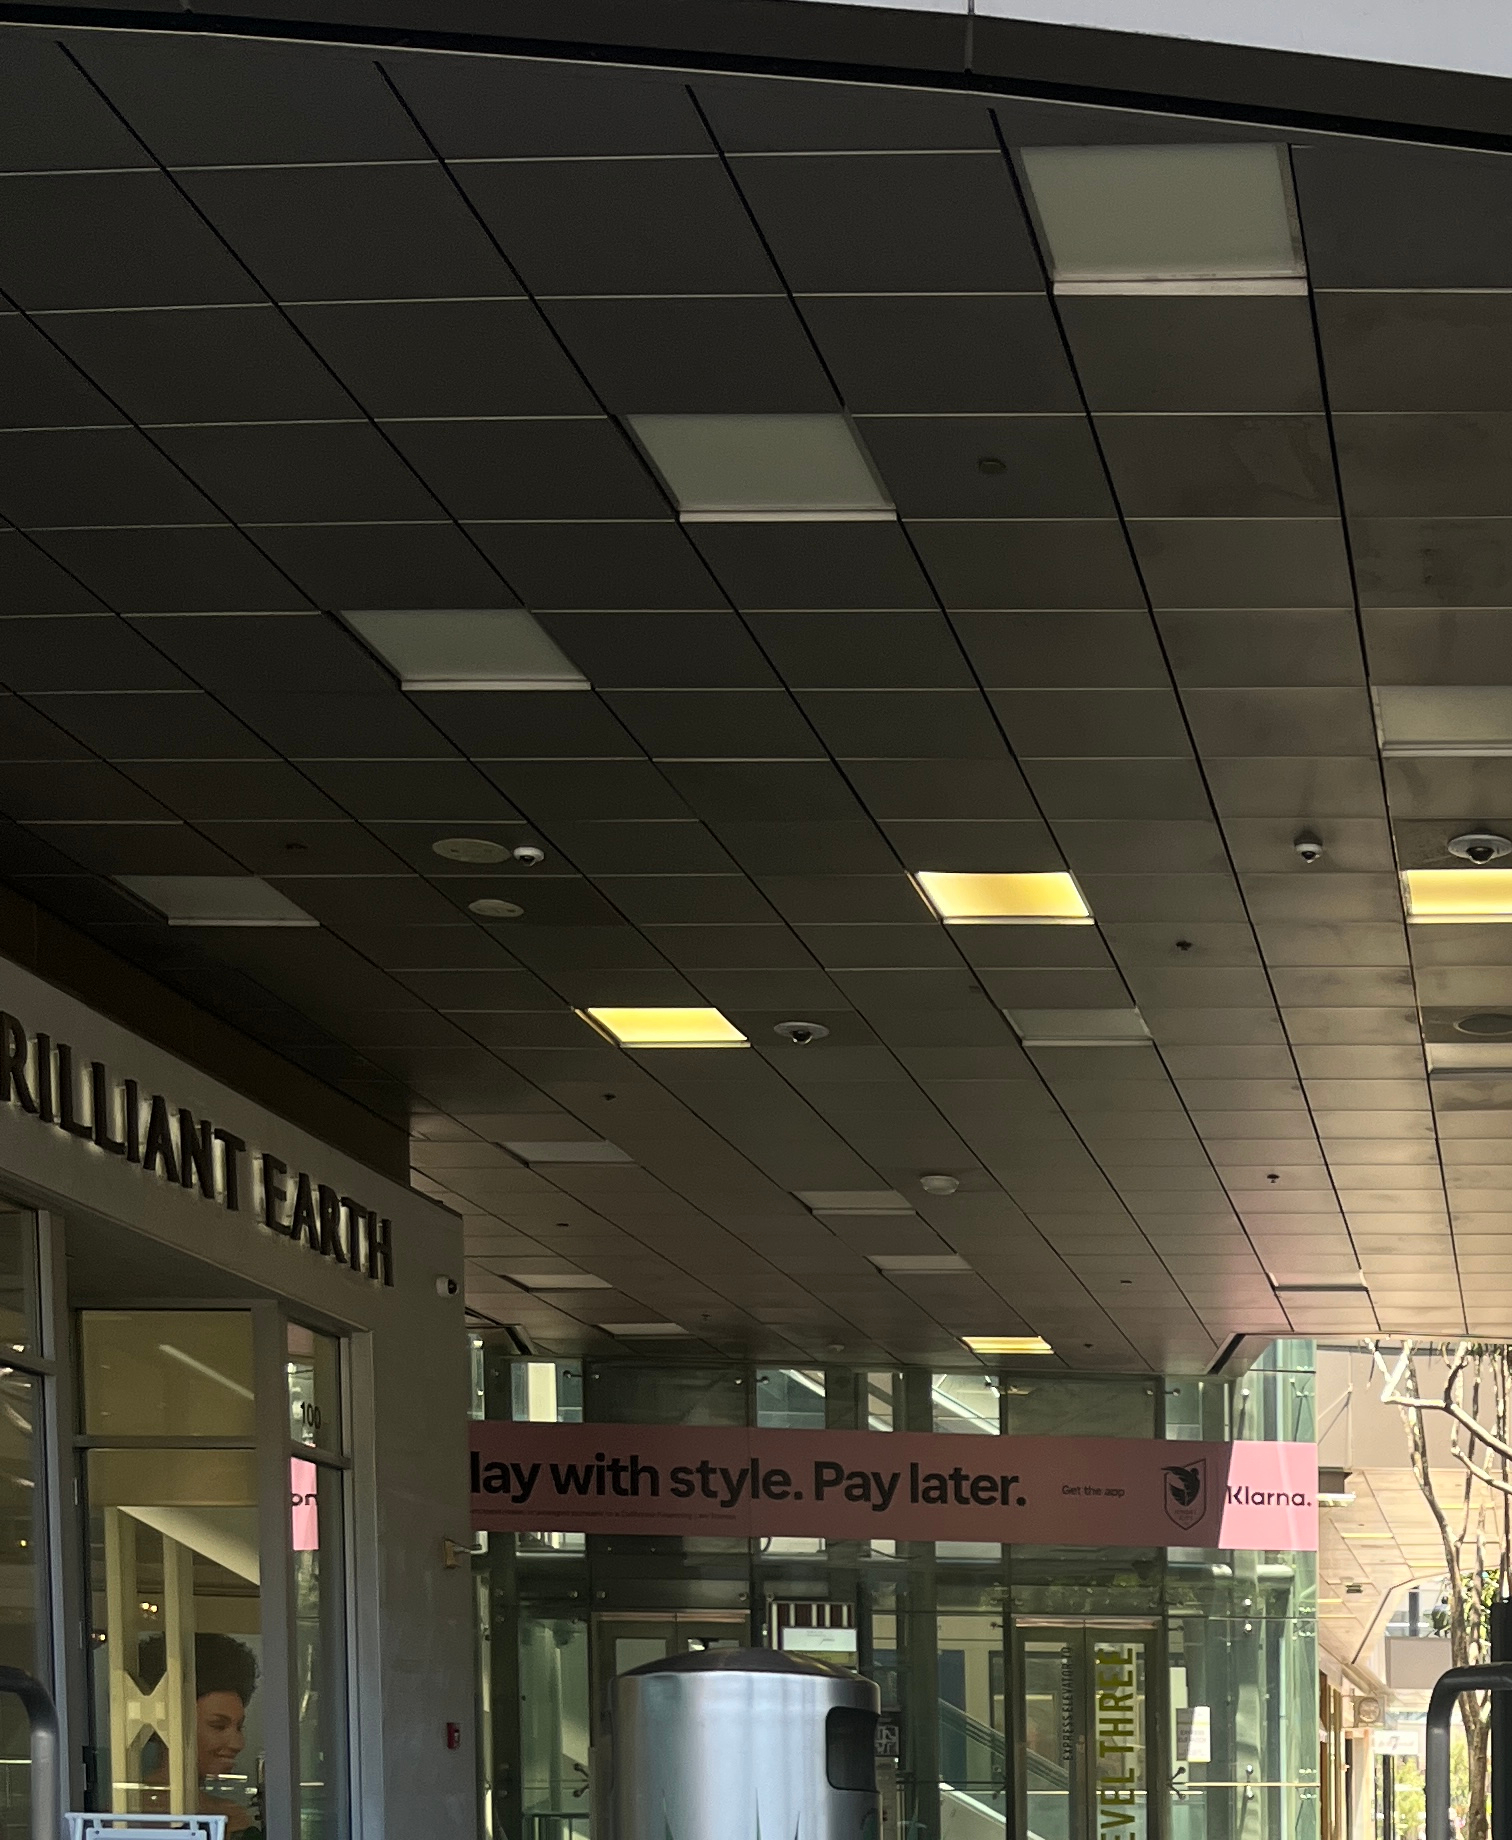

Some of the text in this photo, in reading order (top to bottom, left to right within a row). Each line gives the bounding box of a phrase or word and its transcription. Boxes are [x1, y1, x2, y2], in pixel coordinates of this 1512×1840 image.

[0, 1010, 394, 1287] RILLIANT EARTH
[300, 1401, 321, 1430] 100
[470, 1451, 1027, 1513] lay with style. Pay later.
[1062, 1484, 1125, 1500] Get the app
[1227, 1485, 1312, 1508] Klarna.
[1098, 1648, 1134, 1759] THREE
[1061, 1715, 1073, 1761] EXPRESS
